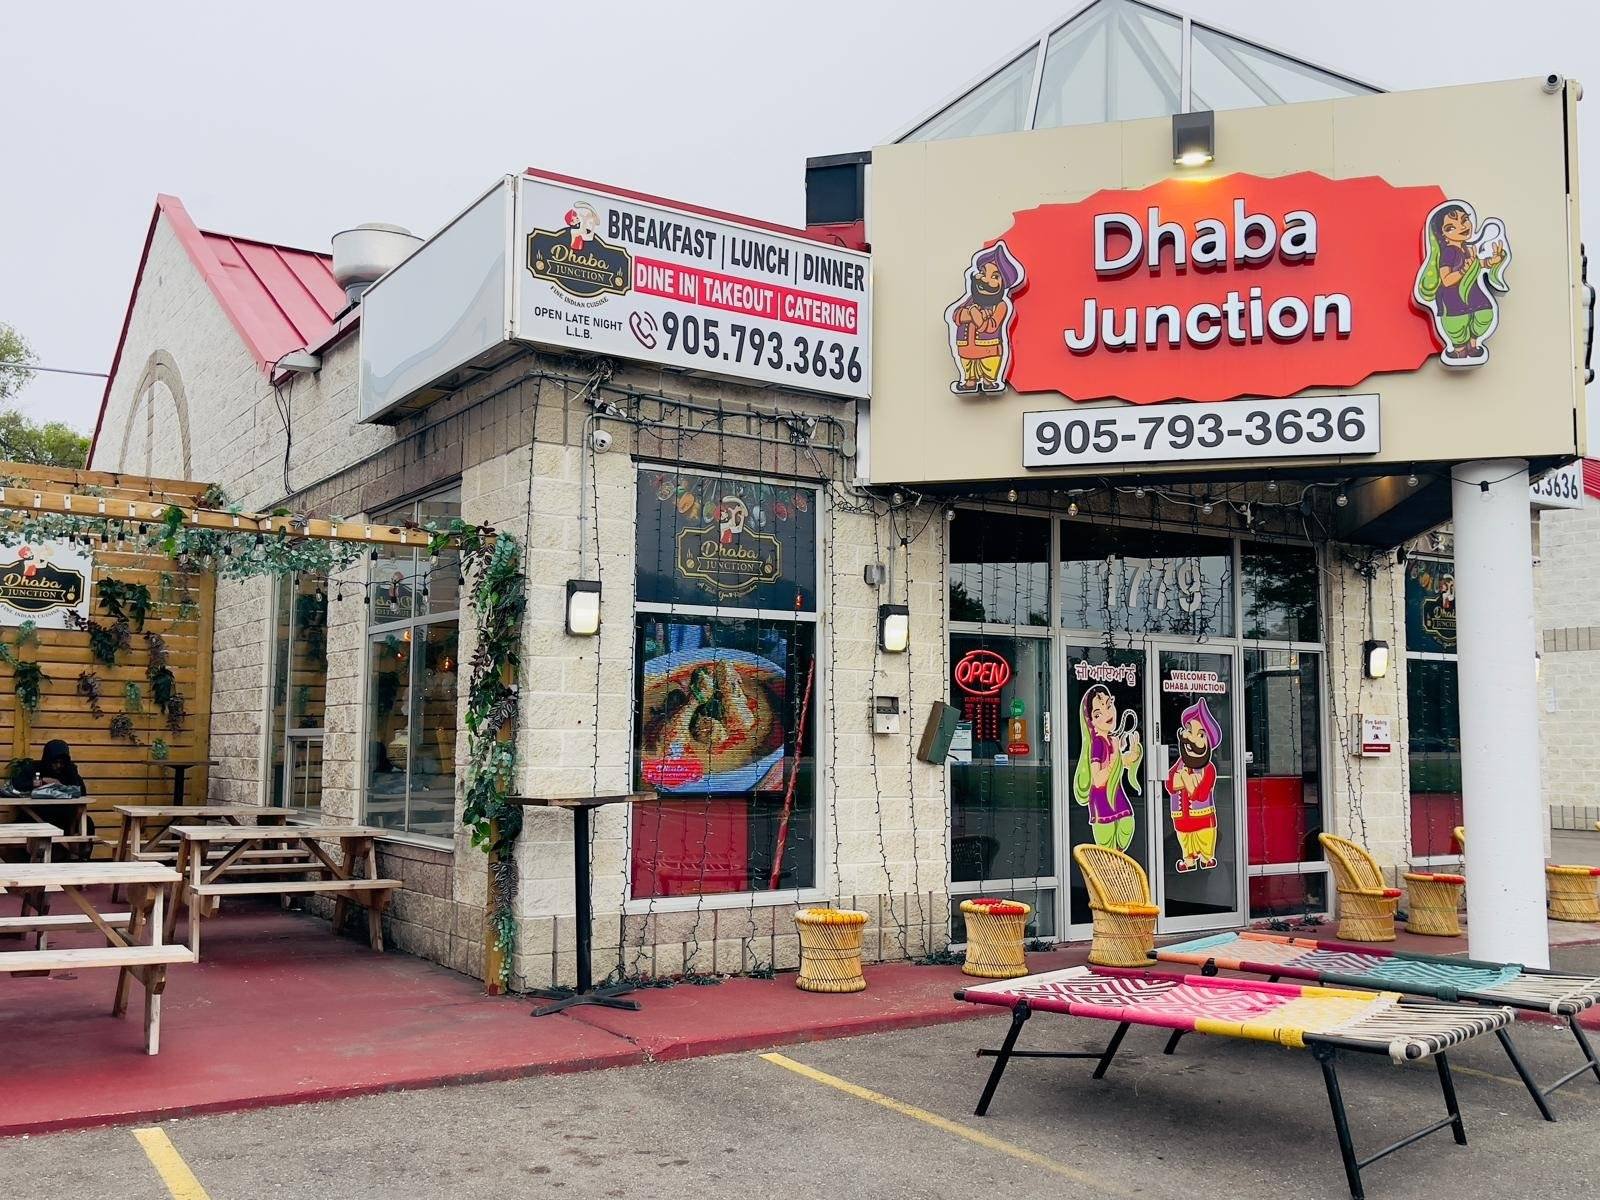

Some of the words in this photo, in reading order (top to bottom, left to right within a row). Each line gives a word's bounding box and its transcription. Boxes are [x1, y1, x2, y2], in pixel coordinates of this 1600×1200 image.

[1093, 198, 1318, 274] Dhaba
[550, 244, 609, 270] Dhaba
[608, 209, 717, 260] BREAKFAST
[731, 237, 789, 276] LUNCH
[803, 253, 865, 292] DINNER
[556, 264, 605, 281] JUNCTION
[550, 285, 563, 299] FINE
[565, 296, 585, 308] INDIAN
[586, 296, 609, 308] CUISINE
[636, 263, 674, 294] DINE
[679, 272, 695, 298] IN
[703, 277, 774, 313] TAKEOUT
[784, 294, 856, 329] CATERING
[534, 306, 562, 320] OPEN
[565, 312, 590, 325] LATE
[593, 318, 623, 331] NIGHT
[1063, 286, 1351, 351] Junction
[566, 325, 593, 339] L.L.B.
[662, 311, 862, 383] 905.793.3636
[1035, 406, 1366, 455] 905-793-3636
[700, 540, 758, 559] Dhaba
[706, 560, 755, 572] JUNCTION
[4, 573, 62, 589] Dhaba
[1098, 555, 1202, 613] 1779
[8, 588, 57, 598] JUNCTION
[958, 661, 1005, 684] OPEN
[1075, 661, 1088, 680] ਜੀ
[1172, 672, 1206, 681] WELCOME
[1208, 673, 1217, 681] TO
[1164, 682, 1188, 691] DHABA
[1190, 683, 1225, 692] JUNCTION
